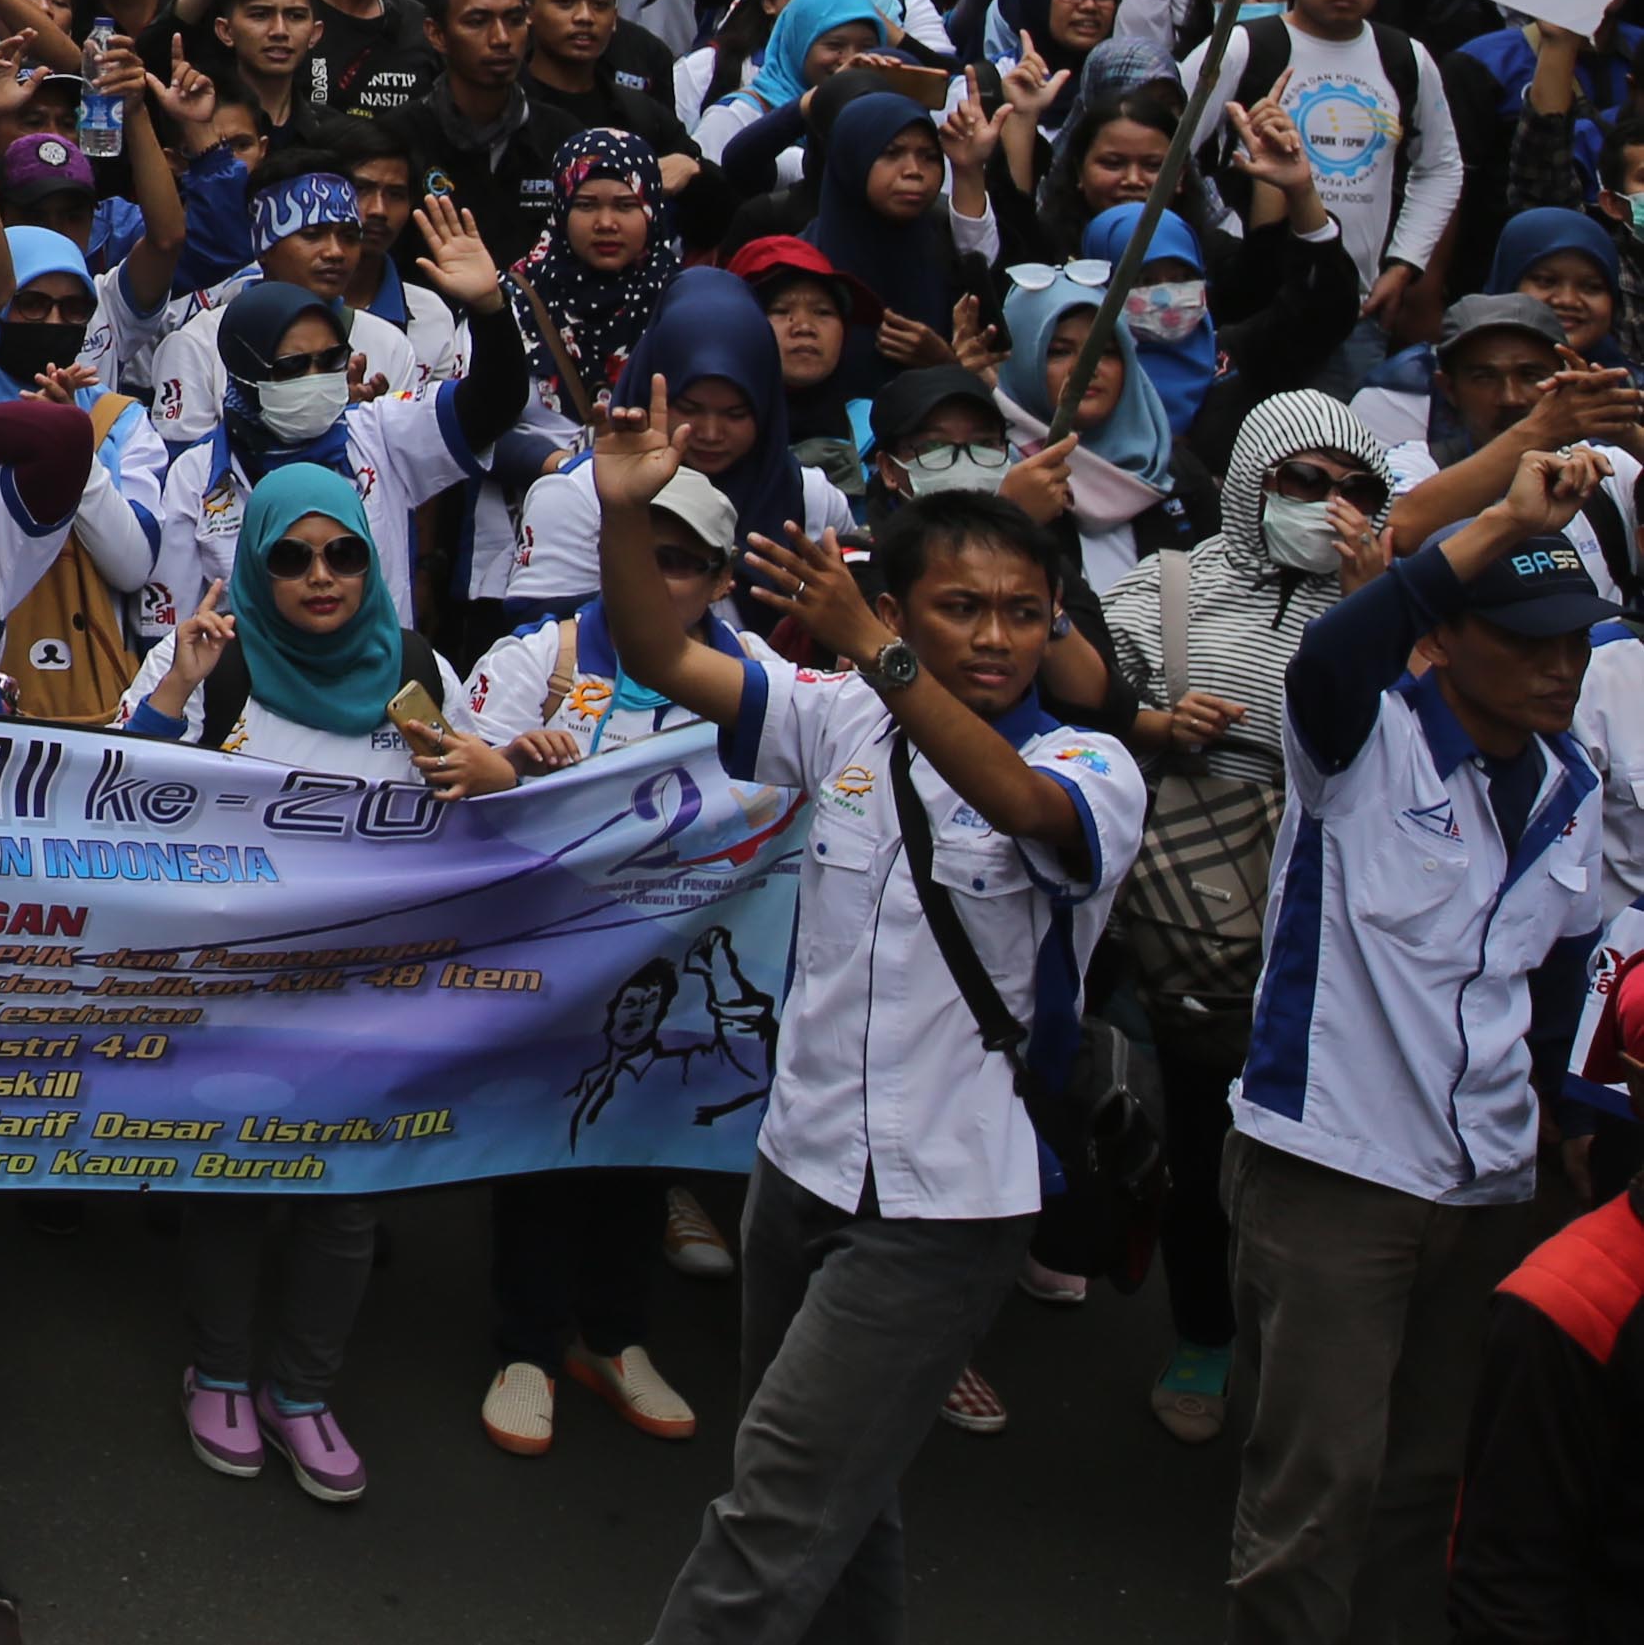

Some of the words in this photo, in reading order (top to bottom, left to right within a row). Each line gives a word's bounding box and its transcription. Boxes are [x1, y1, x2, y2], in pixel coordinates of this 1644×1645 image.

[164, 400, 183, 421] all
[1511, 549, 1579, 576] BASS
[154, 606, 176, 627] all
[44, 837, 280, 885] INDONESIA
[362, 963, 425, 991] 48
[438, 964, 543, 994] Item
[89, 1033, 171, 1062] 4.0
[90, 1111, 224, 1144] Dasar
[236, 1107, 455, 1145] Listrik/TDL
[47, 1148, 181, 1178] Kaum
[191, 1150, 326, 1181] Buruh
